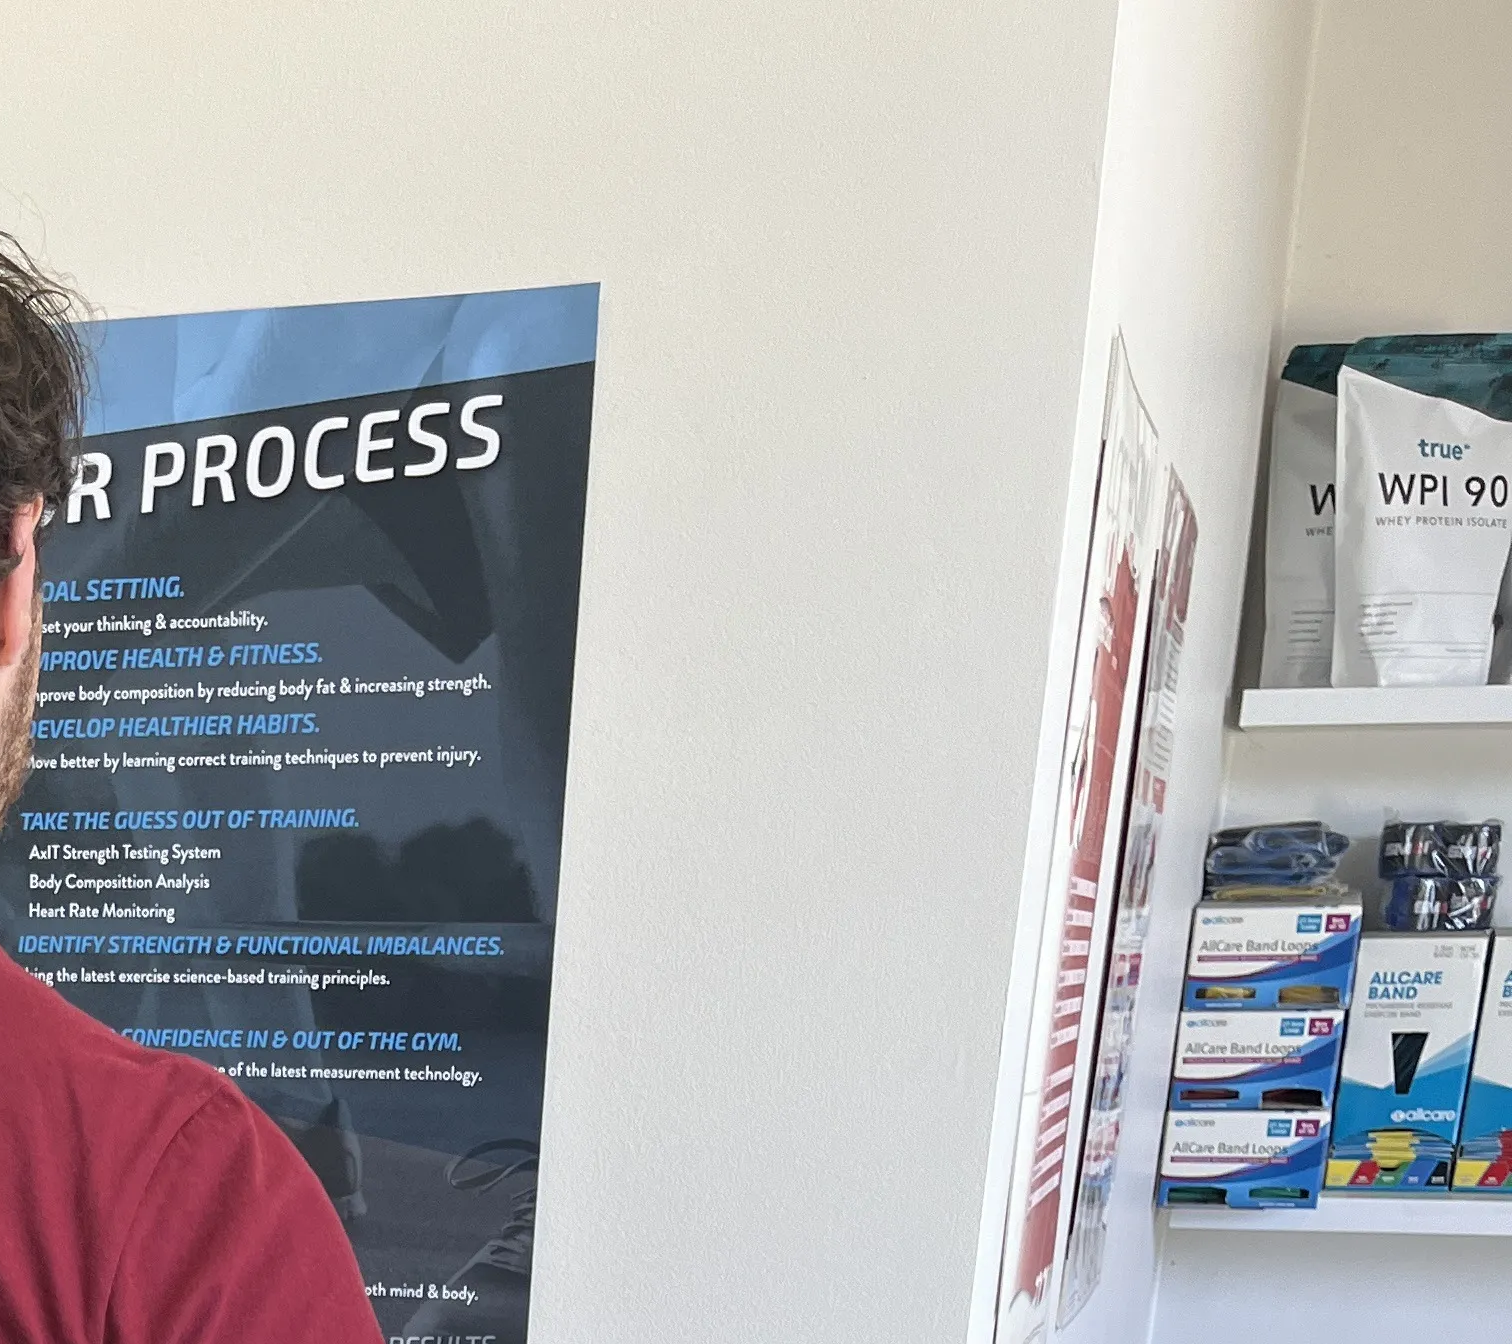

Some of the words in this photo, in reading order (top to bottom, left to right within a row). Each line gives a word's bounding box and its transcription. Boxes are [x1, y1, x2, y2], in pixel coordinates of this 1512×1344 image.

[141, 395, 502, 513] PROCESS
[1378, 472, 1449, 507] WPI
[1464, 475, 1509, 508] 90
[1375, 516, 1411, 527] WHEY
[1416, 516, 1463, 527] PROTEIN
[1466, 517, 1508, 529] ISOLATE
[86, 576, 184, 600] SETTING.
[64, 622, 94, 638] your
[97, 615, 151, 636] thinking
[155, 613, 166, 629] &
[170, 611, 268, 632] accountability.
[122, 647, 203, 669] HEALTH
[208, 646, 225, 666] &
[229, 643, 322, 665] FITNESS.
[79, 685, 111, 705] body
[114, 683, 193, 704] composition
[198, 682, 214, 703] by
[218, 681, 276, 701] reducing
[279, 679, 313, 700] body
[316, 678, 335, 694] fat
[340, 678, 351, 693] &
[355, 676, 424, 697] increasing
[428, 673, 491, 695] strength.
[119, 715, 232, 737] HEALTHIER
[237, 713, 319, 734] HABITS.
[61, 753, 100, 768] better
[104, 753, 120, 773] by
[123, 752, 175, 772] learning
[178, 754, 226, 766] correct
[230, 750, 281, 770] training
[285, 749, 359, 769] techniques
[363, 751, 377, 763] to
[380, 749, 433, 768] prevent
[437, 746, 481, 767] injury.
[21, 812, 69, 830] TAKE
[73, 812, 110, 830] THE
[115, 811, 178, 829] GUESS
[182, 810, 225, 829] OUT
[228, 810, 255, 828] OF
[258, 808, 359, 828] TRAINING.
[63, 845, 119, 865] Strength
[122, 844, 169, 865] Testing
[172, 844, 220, 864] System
[30, 874, 62, 894] Body
[156, 873, 209, 894] Analysis
[29, 903, 65, 917] Heart
[70, 903, 99, 917] Rate
[103, 903, 175, 923] Monitoring
[19, 935, 106, 953] IDENTIFY
[108, 935, 212, 954] STRENGTH
[216, 936, 232, 954] &
[236, 936, 362, 954] FUNCTIONAL
[367, 936, 504, 955] IMBALANCES.
[1246, 939, 1279, 952] Band
[57, 967, 77, 982] the
[81, 967, 115, 982] latest
[119, 968, 170, 983] exercise
[174, 968, 264, 984] science-based
[268, 969, 319, 989] training
[322, 970, 390, 990] principles.
[1370, 971, 1443, 986] ALLCARE
[1368, 986, 1418, 1001] BAND
[247, 1030, 268, 1048] IN
[272, 1030, 288, 1048] &
[293, 1031, 335, 1049] OUT
[338, 1032, 365, 1049] OF
[369, 1032, 408, 1050] THE
[412, 1033, 461, 1051] GYM.
[1230, 1042, 1262, 1054] Band
[228, 1062, 244, 1076] of
[246, 1062, 267, 1077] the
[271, 1062, 307, 1078] latest
[310, 1068, 400, 1080] measurement
[404, 1065, 482, 1086] technology.
